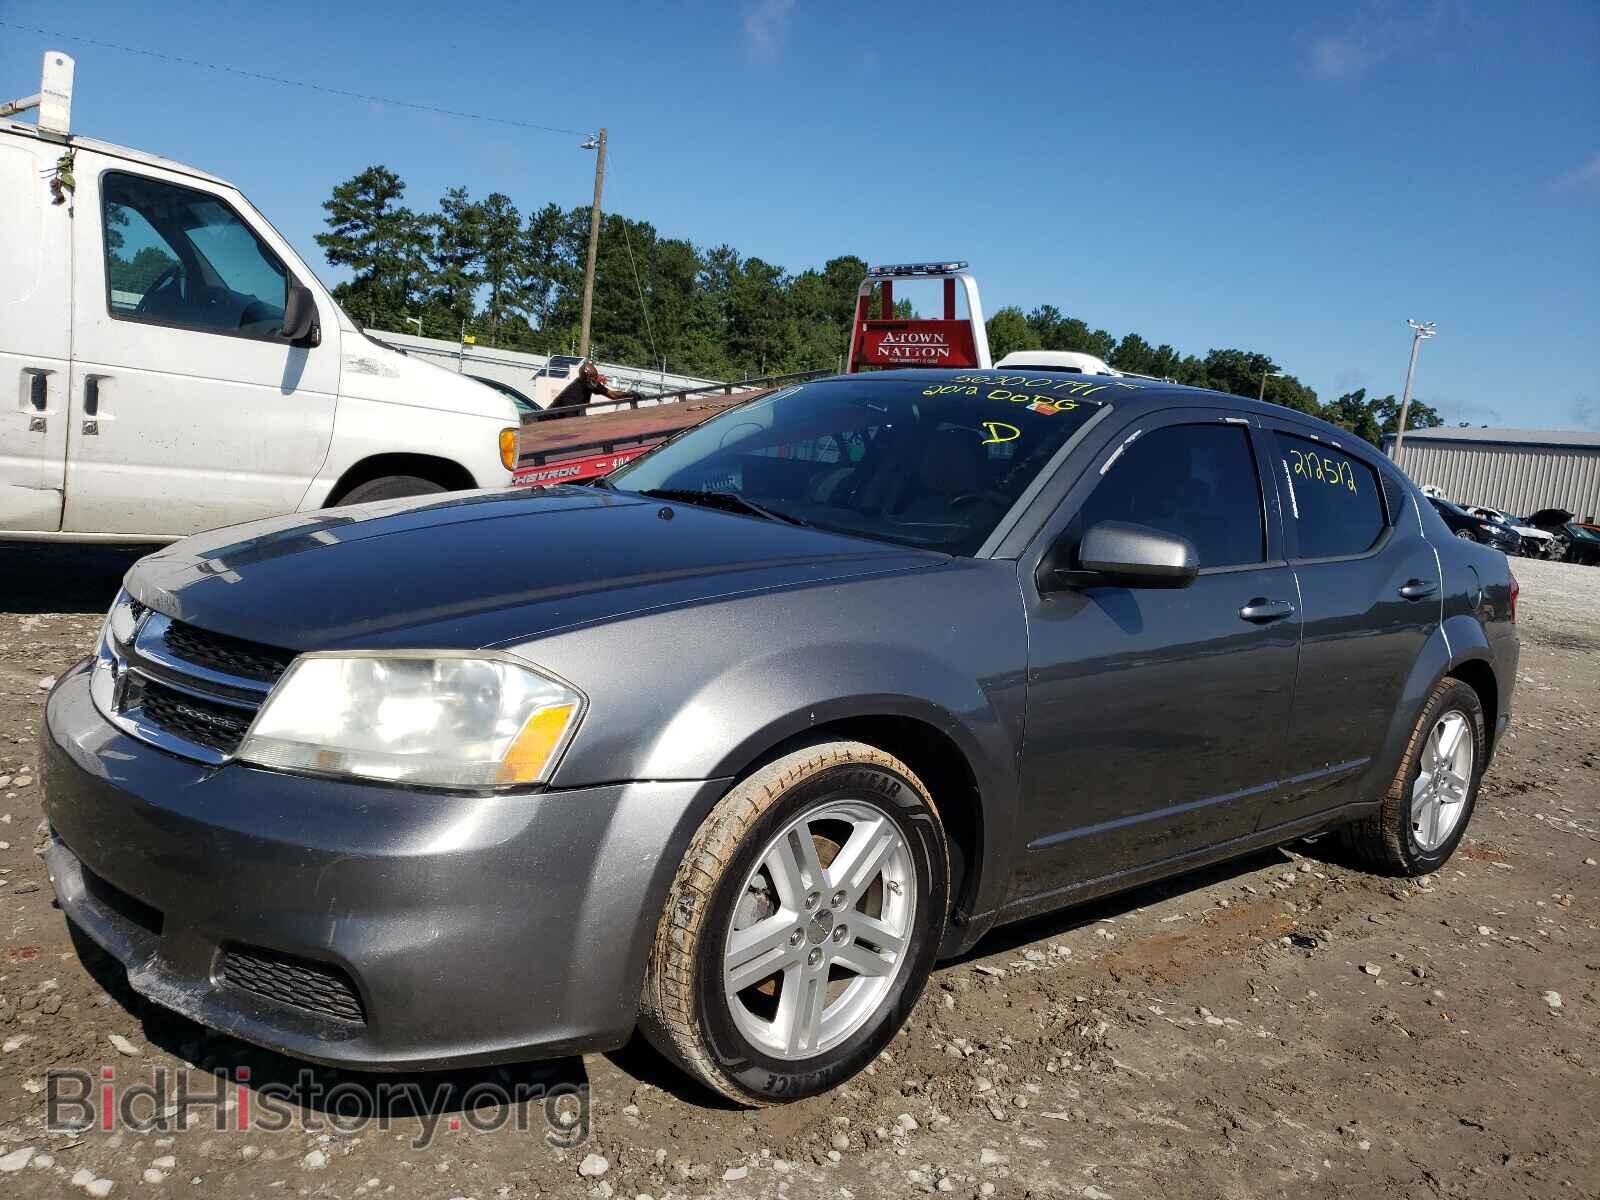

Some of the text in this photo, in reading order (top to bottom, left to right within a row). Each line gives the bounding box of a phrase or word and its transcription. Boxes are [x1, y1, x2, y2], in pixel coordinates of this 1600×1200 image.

[883, 331, 945, 343] A-TOWN
[877, 346, 950, 357] NATION
[981, 421, 1021, 445] D
[1290, 450, 1358, 496] 212512
